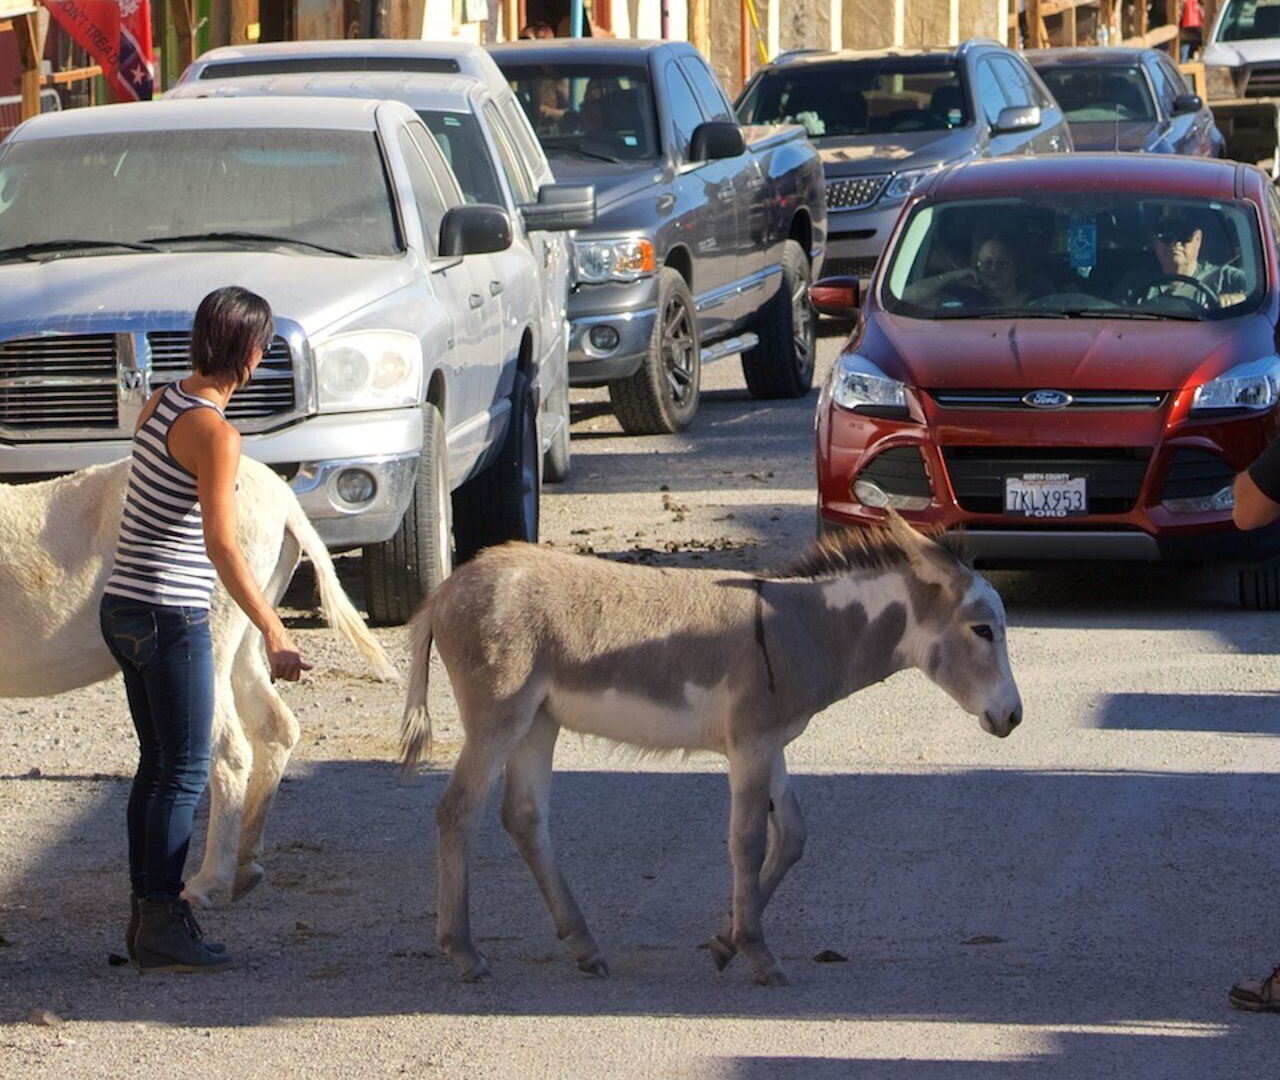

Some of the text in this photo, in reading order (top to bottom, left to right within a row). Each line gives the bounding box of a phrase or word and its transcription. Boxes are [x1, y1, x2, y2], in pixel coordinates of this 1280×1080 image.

[1033, 391, 1060, 405] Ford
[1010, 490, 1083, 510] 7KLX953
[1025, 509, 1067, 517] FORD
